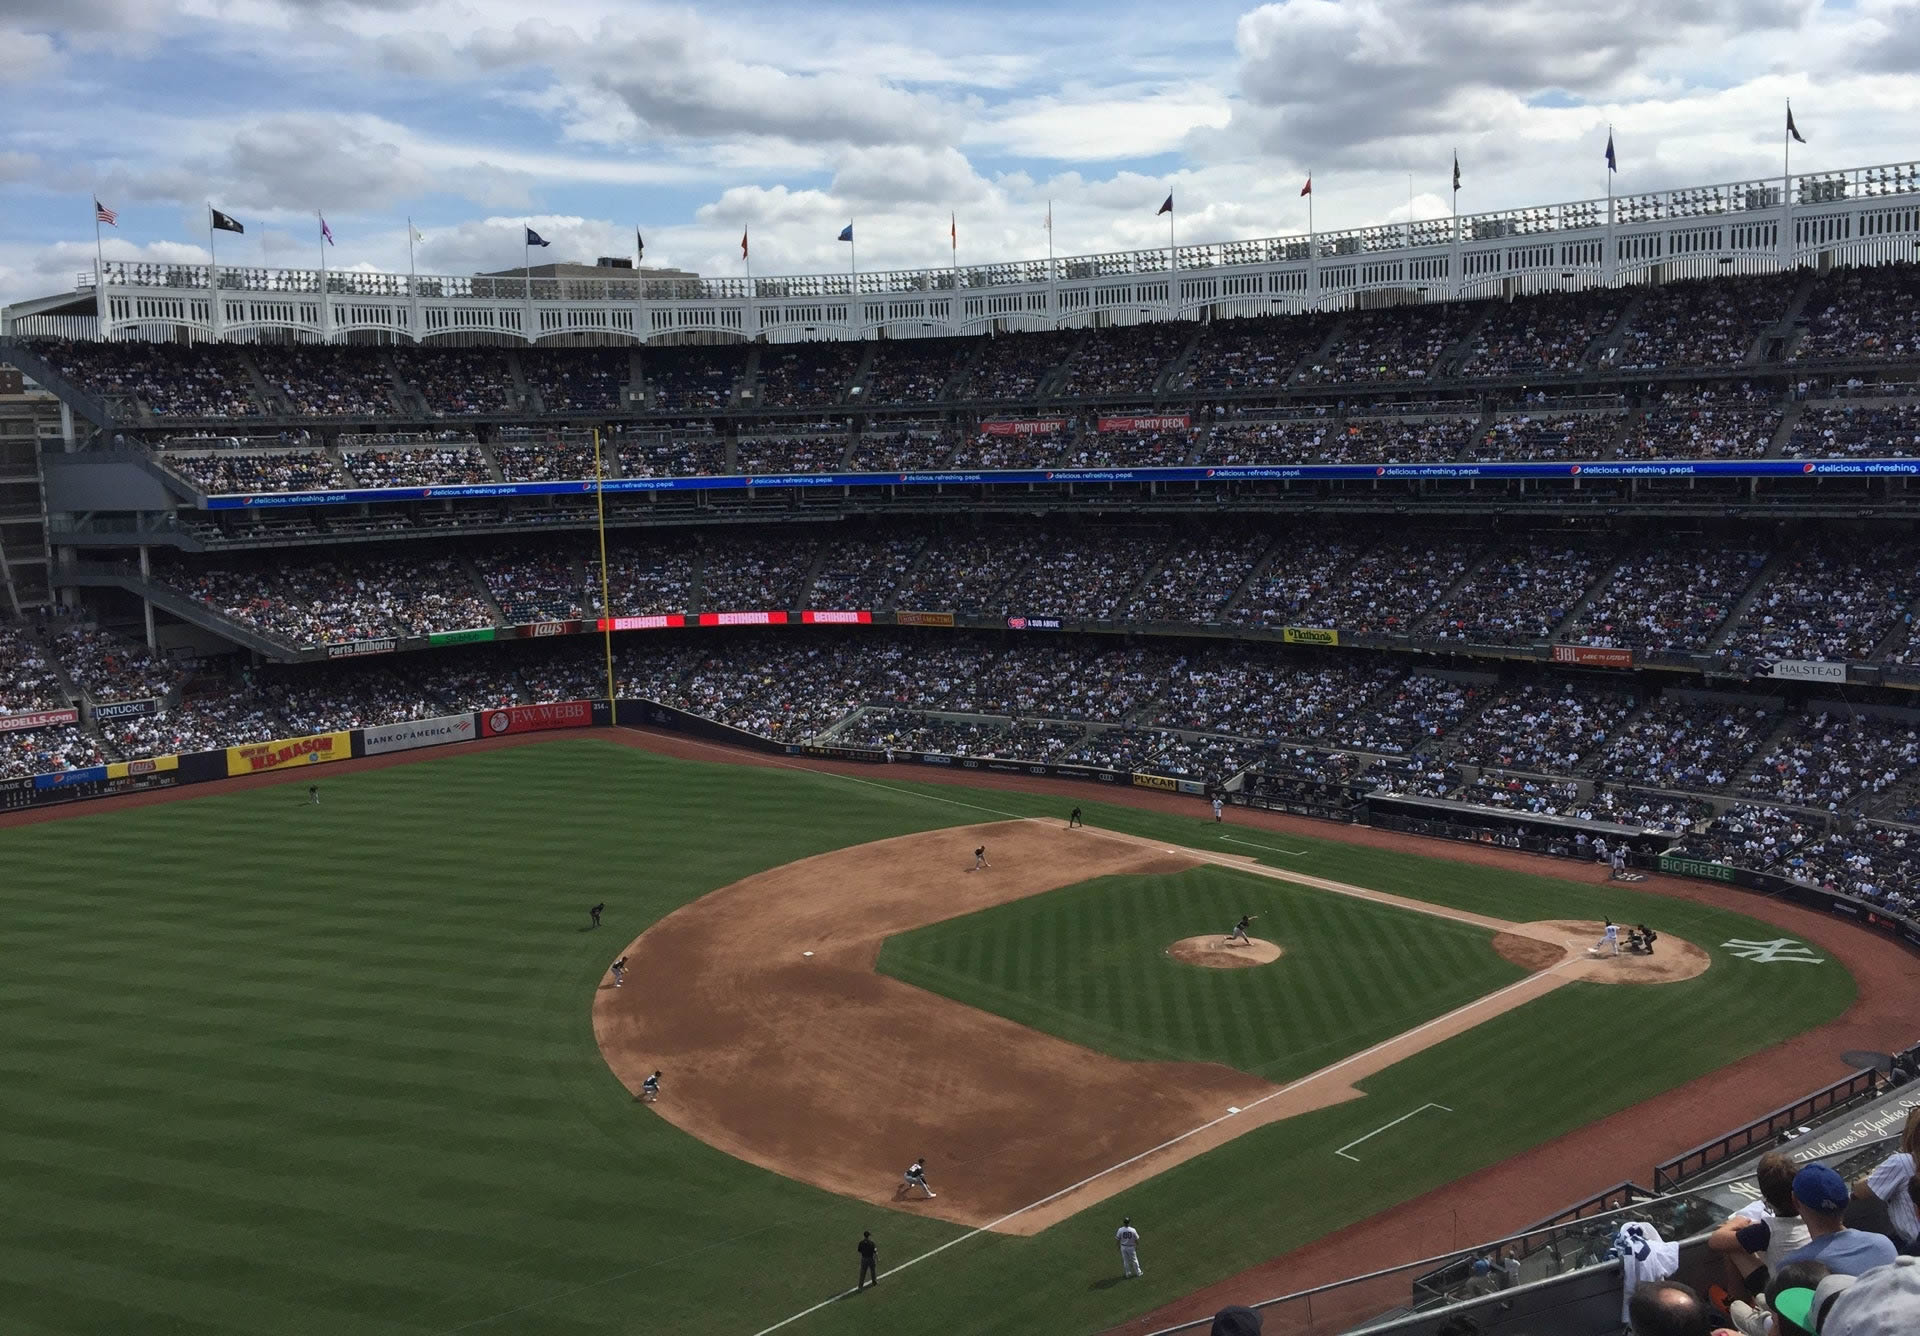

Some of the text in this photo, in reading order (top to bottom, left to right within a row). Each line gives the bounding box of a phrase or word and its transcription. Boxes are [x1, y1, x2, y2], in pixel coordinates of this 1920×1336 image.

[1015, 422, 1040, 432] PARTY
[1040, 421, 1061, 431] DECK
[1134, 419, 1162, 429] PARTY
[1161, 417, 1185, 428] DECK
[614, 615, 667, 630] BENIHANA
[718, 612, 769, 625] BENIHANA
[813, 611, 859, 624] BENIHANA
[1032, 619, 1042, 627] SUB
[1043, 620, 1059, 628] ABOVE
[1288, 629, 1332, 641] Nathan's
[328, 645, 353, 656] Parts
[354, 640, 396, 652] Authority
[1556, 648, 1579, 661] JBL
[1780, 664, 1842, 677] HALSTEAD
[98, 704, 146, 717] UNTUCKit
[511, 708, 537, 723] F.W.
[539, 705, 584, 719] WEBB
[366, 726, 452, 745] BANK OF AMERICA
[923, 755, 950, 763] GEICO
[66, 771, 90, 782] pepsi
[1134, 774, 1175, 789] PLYCAR
[1854, 1109, 1910, 1137] Yankee
[1853, 1127, 1868, 1139] to
[1793, 1134, 1858, 1162] Welcome
